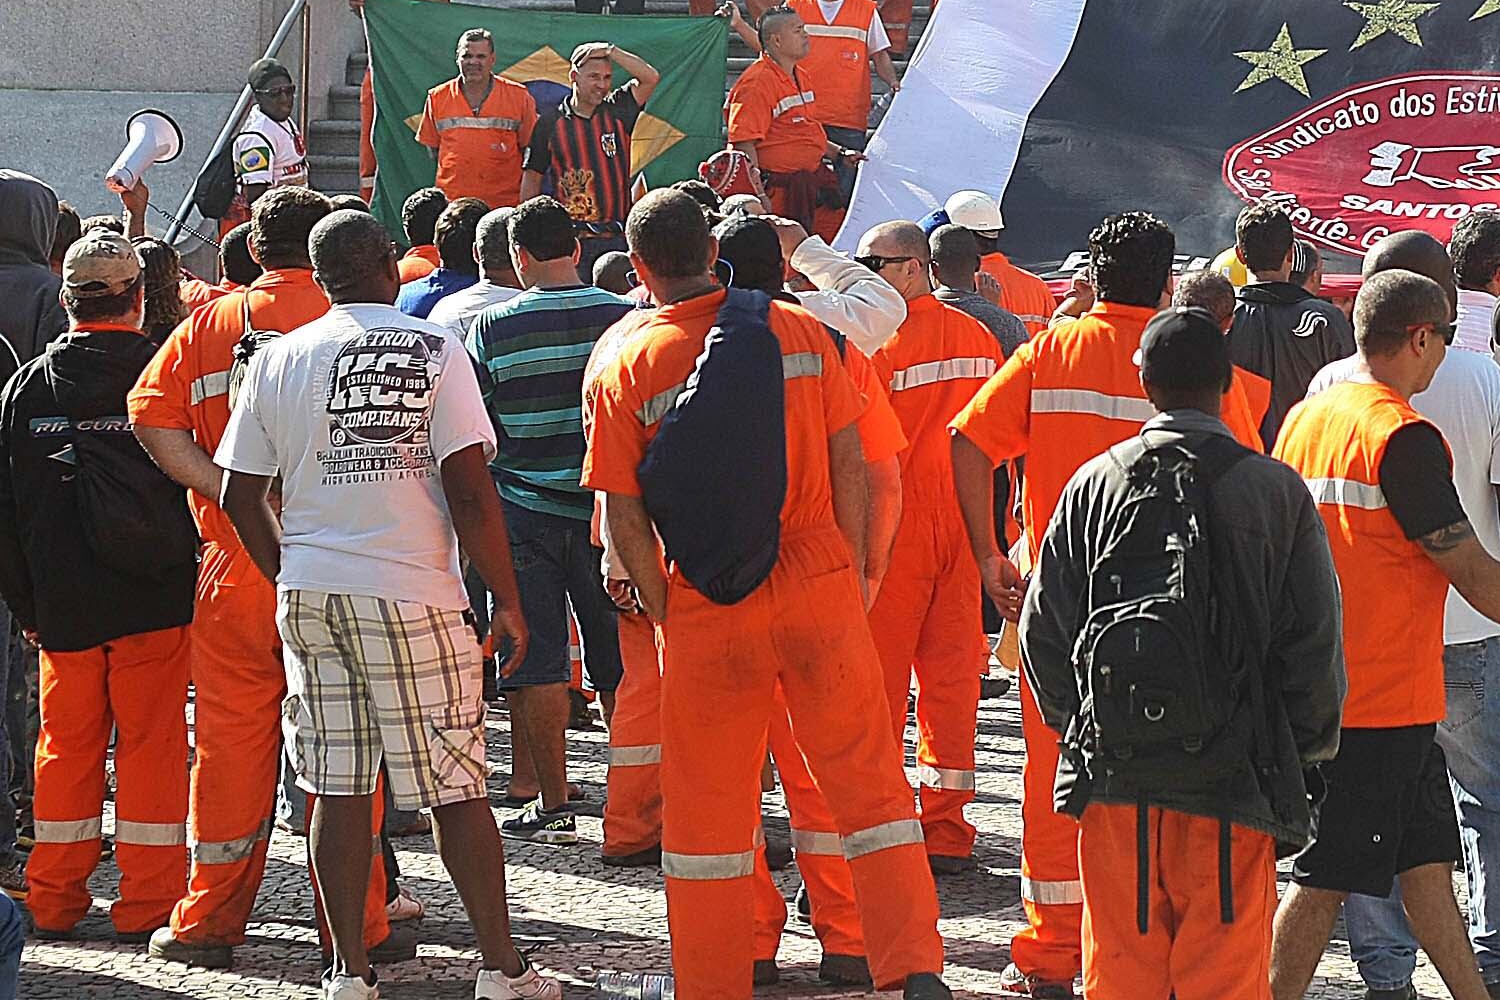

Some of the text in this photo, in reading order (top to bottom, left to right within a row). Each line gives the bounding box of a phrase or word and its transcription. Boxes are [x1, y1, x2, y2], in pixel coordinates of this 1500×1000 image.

[1250, 100, 1379, 159] Sindicato
[1390, 88, 1435, 117] dos
[346, 374, 402, 387] ESTABLISHED
[76, 420, 133, 431] CURL
